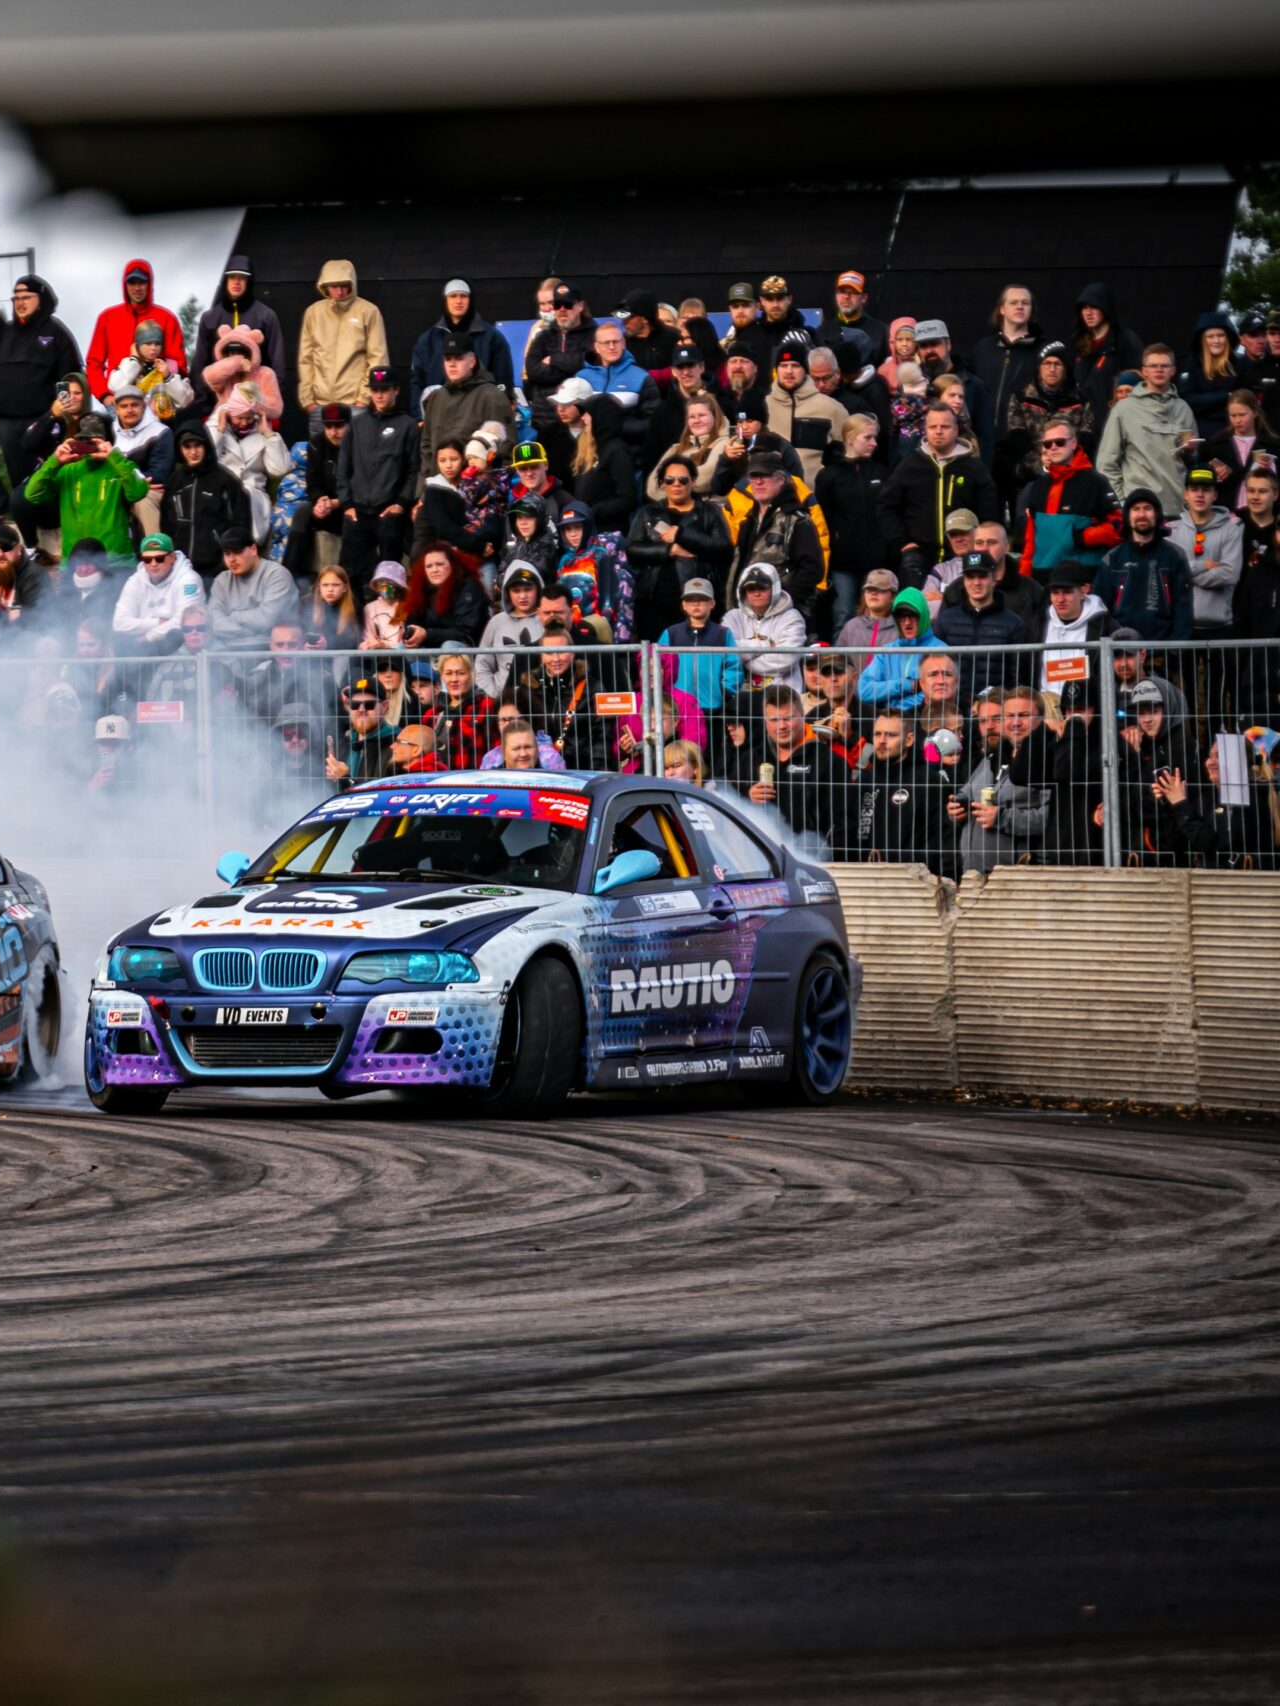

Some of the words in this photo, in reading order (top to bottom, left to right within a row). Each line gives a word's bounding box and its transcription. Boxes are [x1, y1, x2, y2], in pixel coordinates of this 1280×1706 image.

[318, 794, 379, 813] 95
[408, 794, 489, 809] DRIFT
[549, 803, 588, 816] PRO
[681, 803, 715, 830] 95
[256, 901, 358, 910] RAUTIO
[639, 897, 655, 912] 95
[191, 918, 372, 929] KAARAX
[610, 959, 736, 1013] RAUTIO
[245, 1010, 283, 1022] EVENTS
[390, 1010, 407, 1021] JP
